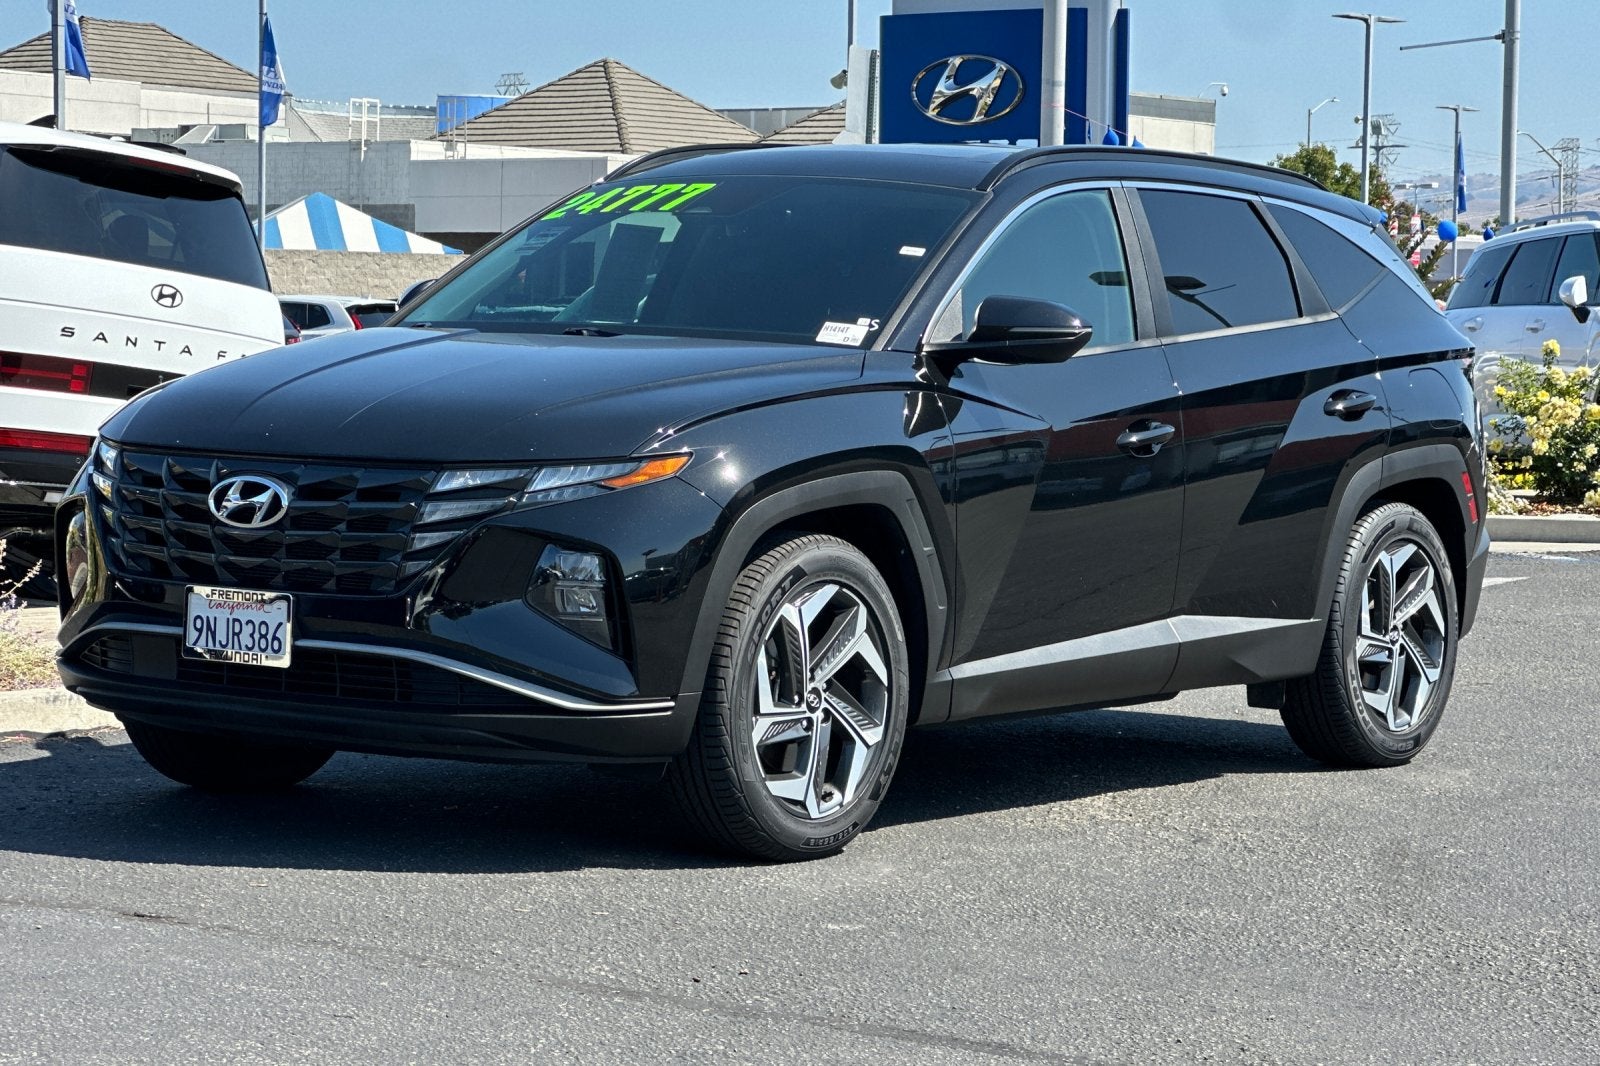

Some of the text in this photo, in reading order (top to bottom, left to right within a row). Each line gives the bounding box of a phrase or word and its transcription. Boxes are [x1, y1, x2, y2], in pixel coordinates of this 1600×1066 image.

[541, 183, 716, 221] 24777
[59, 325, 193, 357] SANTA
[210, 588, 266, 603] FREMONT
[192, 614, 284, 655] 9NJR386
[746, 575, 795, 660] SPORT
